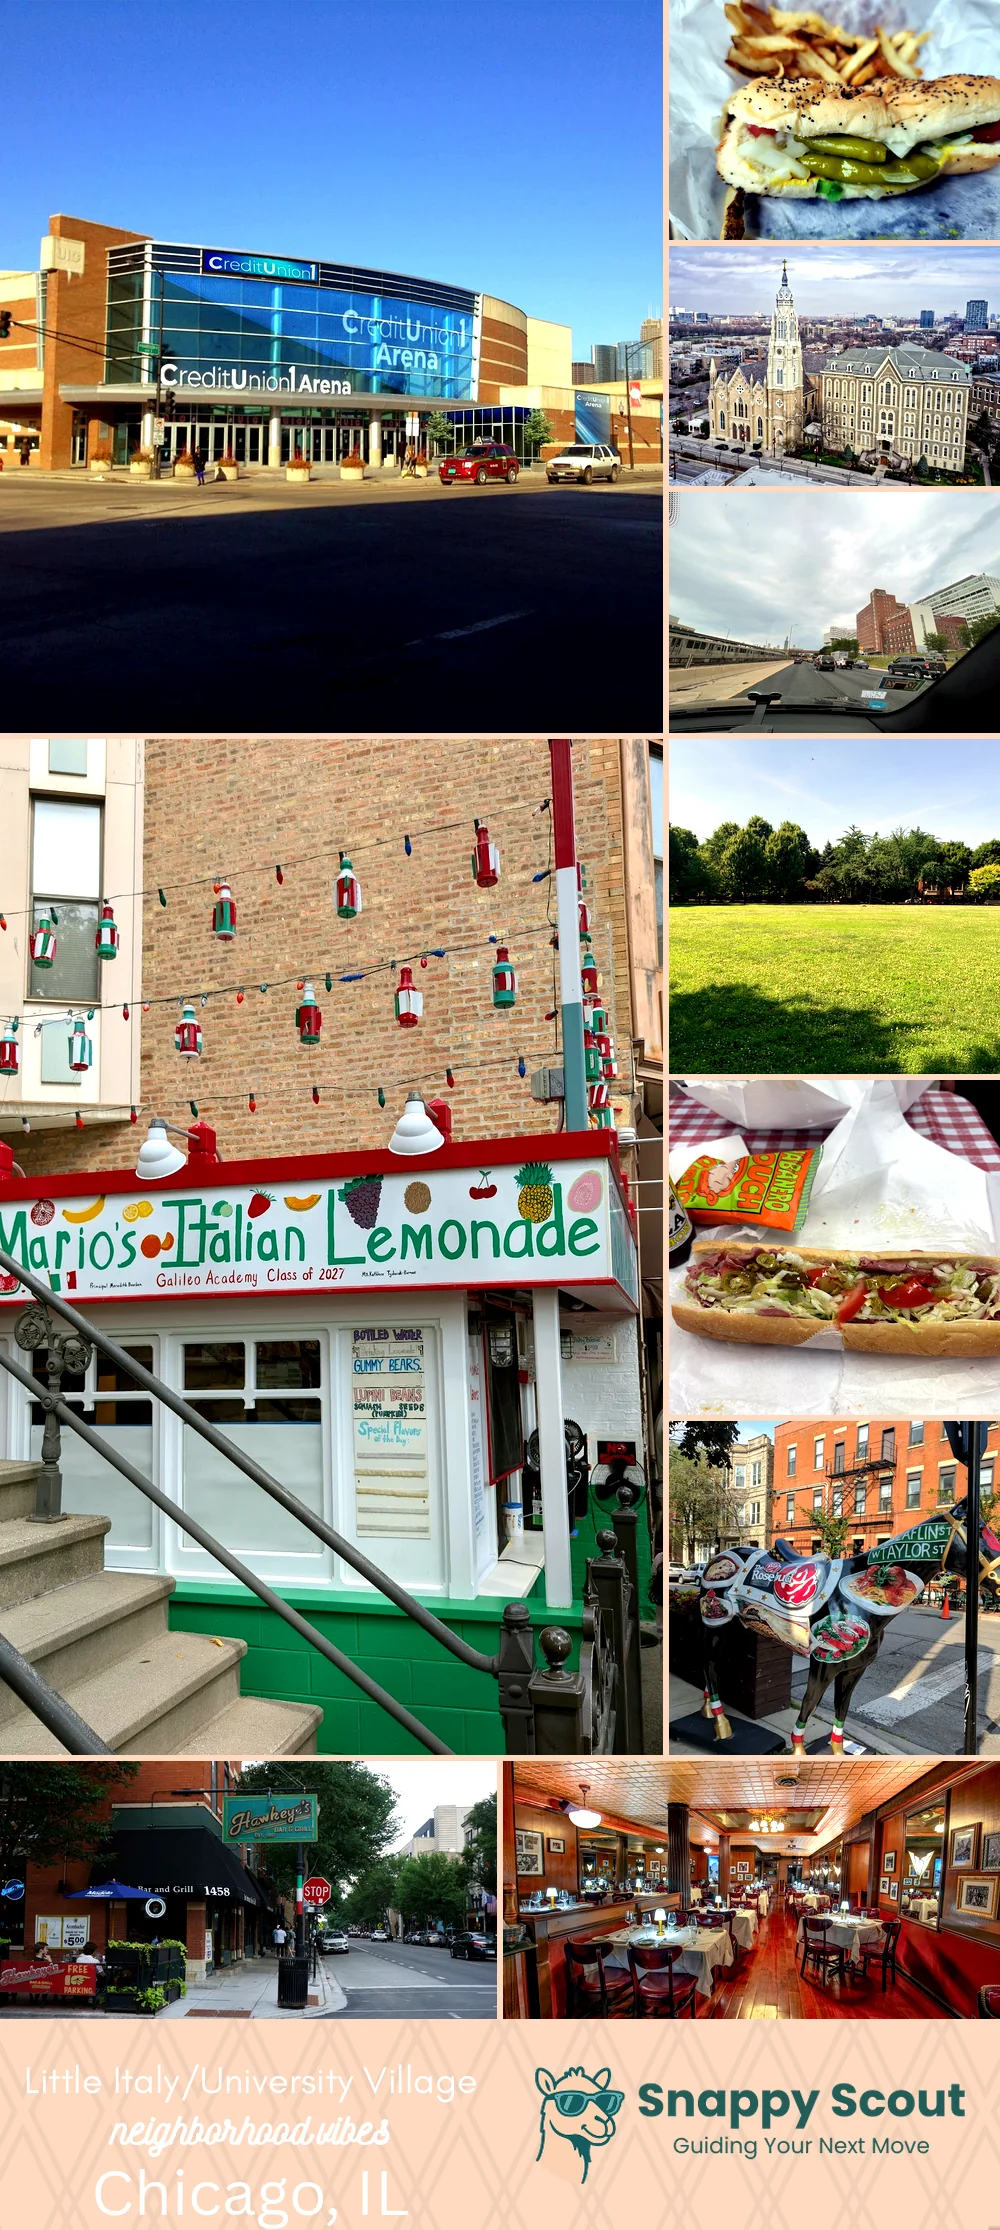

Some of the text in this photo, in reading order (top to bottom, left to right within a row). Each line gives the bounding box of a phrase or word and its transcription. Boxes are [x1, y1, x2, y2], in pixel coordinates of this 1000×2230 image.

[208, 256, 316, 281] CreditUnion1
[342, 309, 466, 348] CreditUnion1
[376, 343, 438, 371] Arena
[160, 363, 352, 396] CreditUnion1 Arena
[736, 1153, 776, 1210] OUCH
[0, 1182, 601, 1270] Mario's Italian Lemonade
[156, 1267, 345, 1287] Galileo Academy Class of 2027
[353, 1328, 423, 1343] BOTTLED WATER
[353, 1359, 384, 1373] GUMMY
[353, 1388, 423, 1402] LUPINI BEANS
[353, 1403, 425, 1412] SQUASH SEEDS
[357, 1420, 422, 1440] Special Flavors
[383, 1434, 394, 1443] the
[606, 1442, 627, 1453] NO
[939, 1526, 953, 1536] ST
[872, 1543, 946, 1560] W TAYLOR ST
[228, 1799, 312, 1838] Hawkeye's
[154, 1885, 170, 1893] and
[172, 1885, 194, 1893] Grill
[204, 1885, 231, 1896] 1458
[304, 1885, 329, 1897] STOP
[67, 1964, 88, 1974] FREE
[64, 1986, 93, 1995] PARKING
